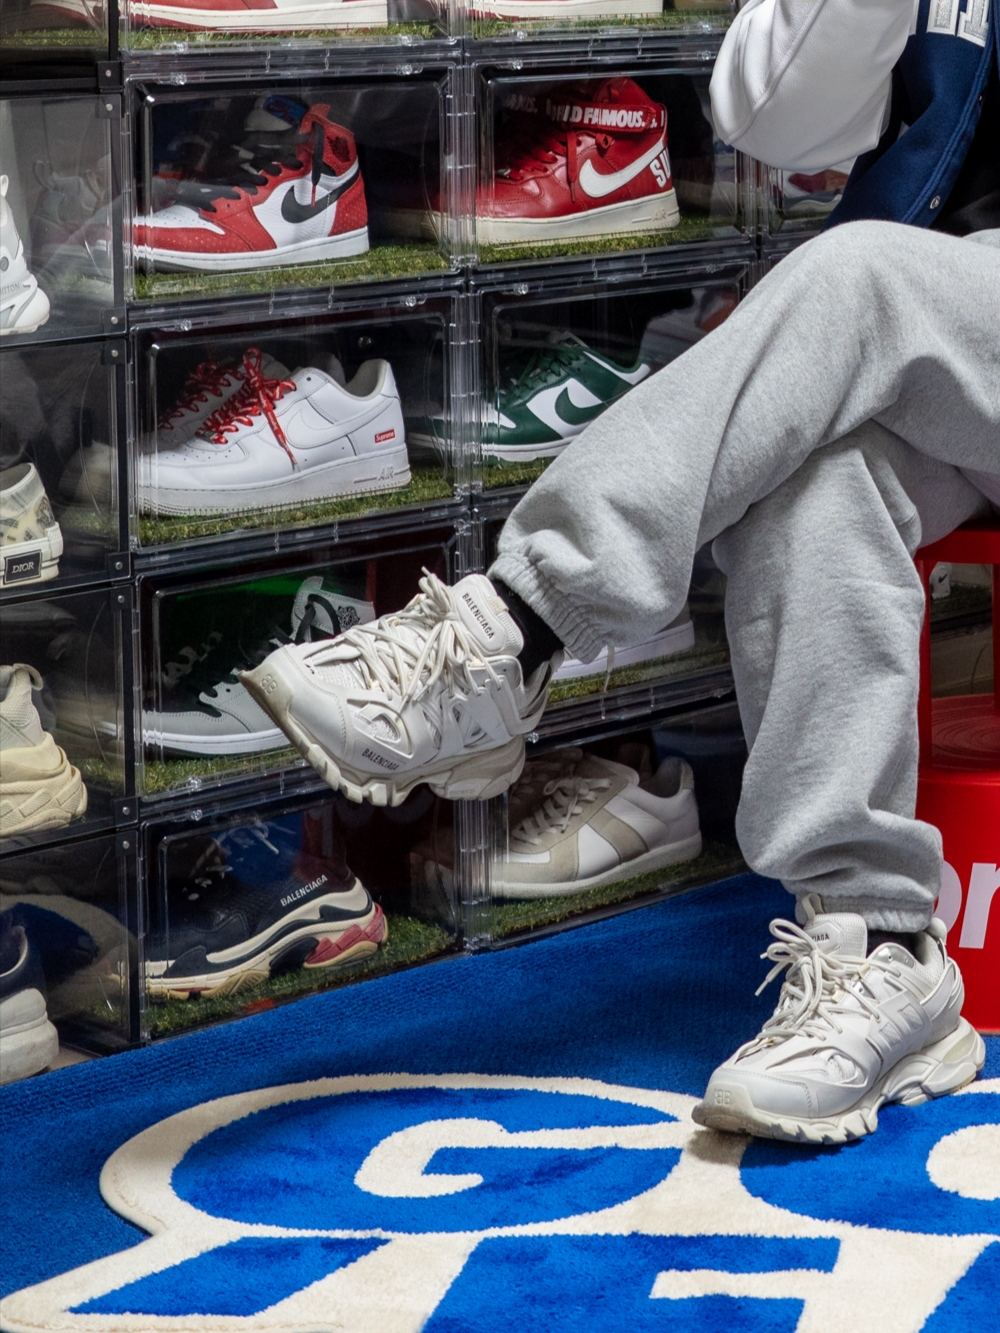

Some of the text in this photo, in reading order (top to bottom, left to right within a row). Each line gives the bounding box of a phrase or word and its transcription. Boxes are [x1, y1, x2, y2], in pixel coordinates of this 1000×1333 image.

[11, 561, 35, 574] DIOR
[462, 592, 495, 640] BALENCIAGA
[361, 748, 399, 772] BALENCIAGA
[280, 874, 328, 907] BALENCIAGA
